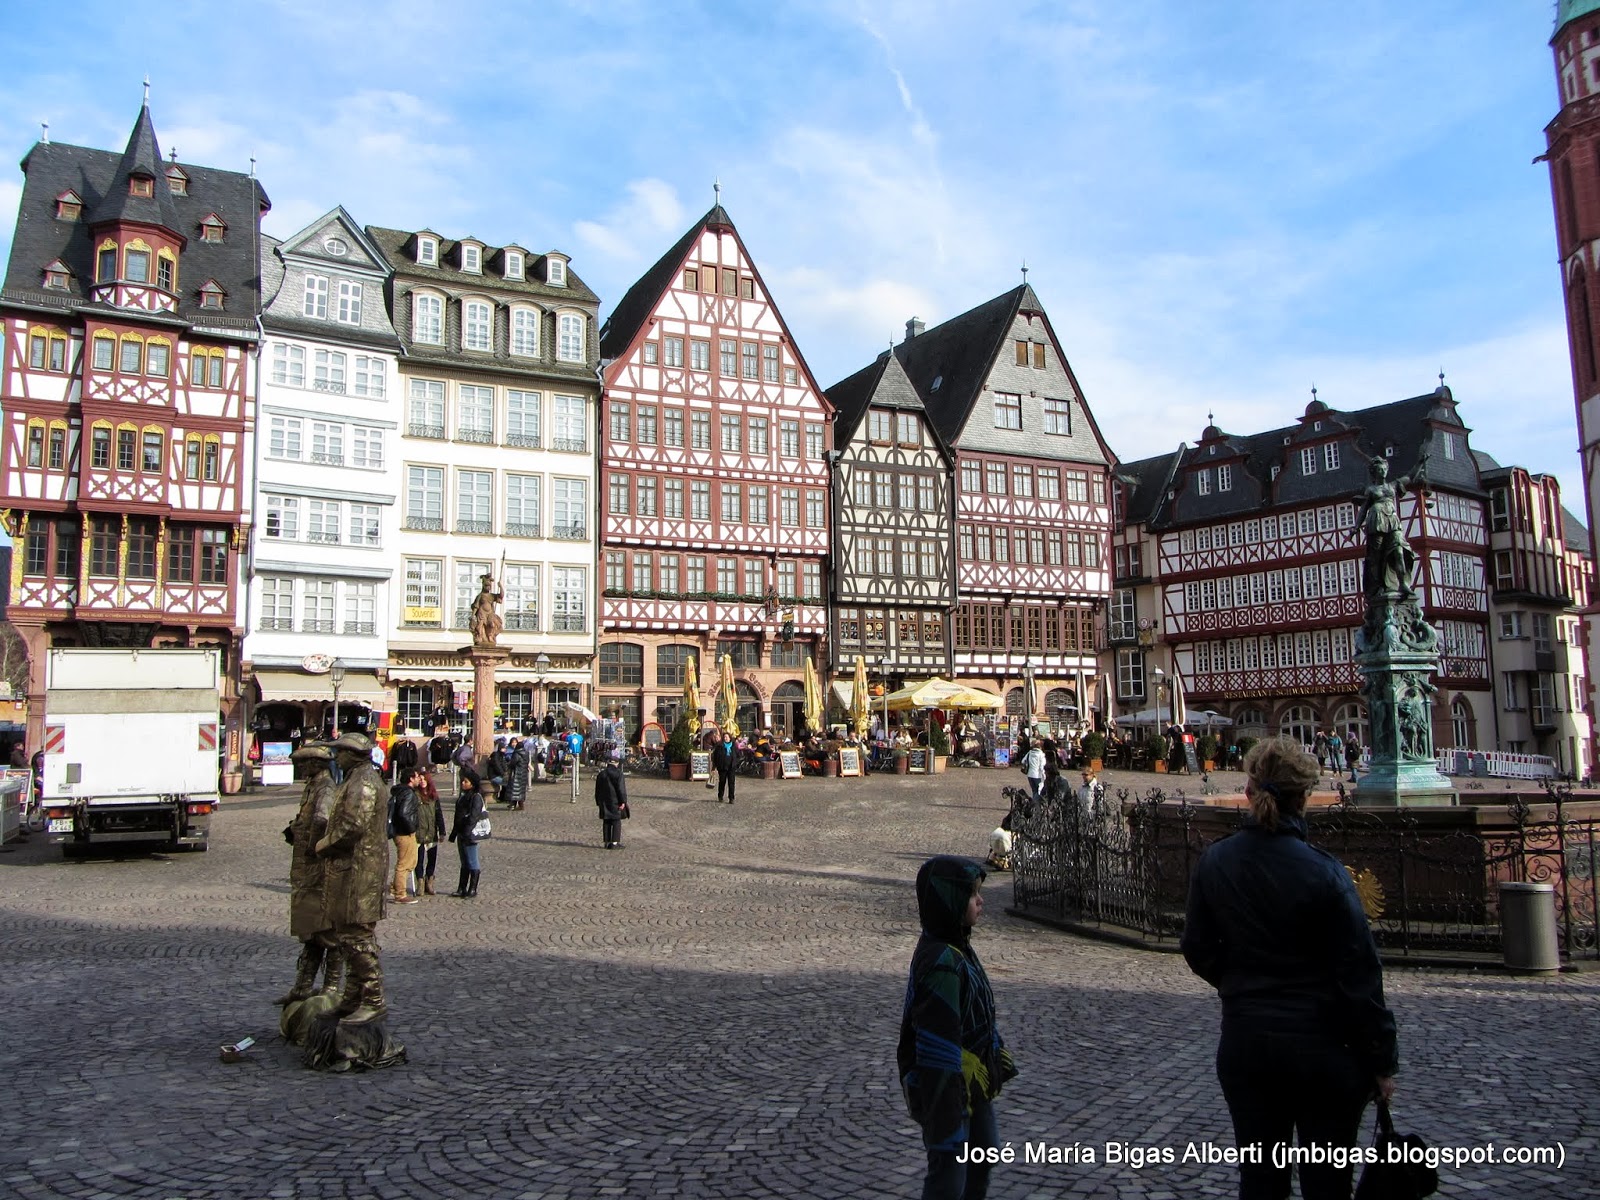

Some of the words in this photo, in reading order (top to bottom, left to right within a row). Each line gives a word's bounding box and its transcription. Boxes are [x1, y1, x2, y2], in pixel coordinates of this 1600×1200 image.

[411, 608, 436, 618] Souvenirs
[396, 654, 466, 667] Souvenirs
[511, 656, 584, 669] Gesenke
[1224, 688, 1272, 699] RESTAURANT
[1276, 685, 1326, 696] SCHWARZER
[1329, 683, 1360, 693] STERN
